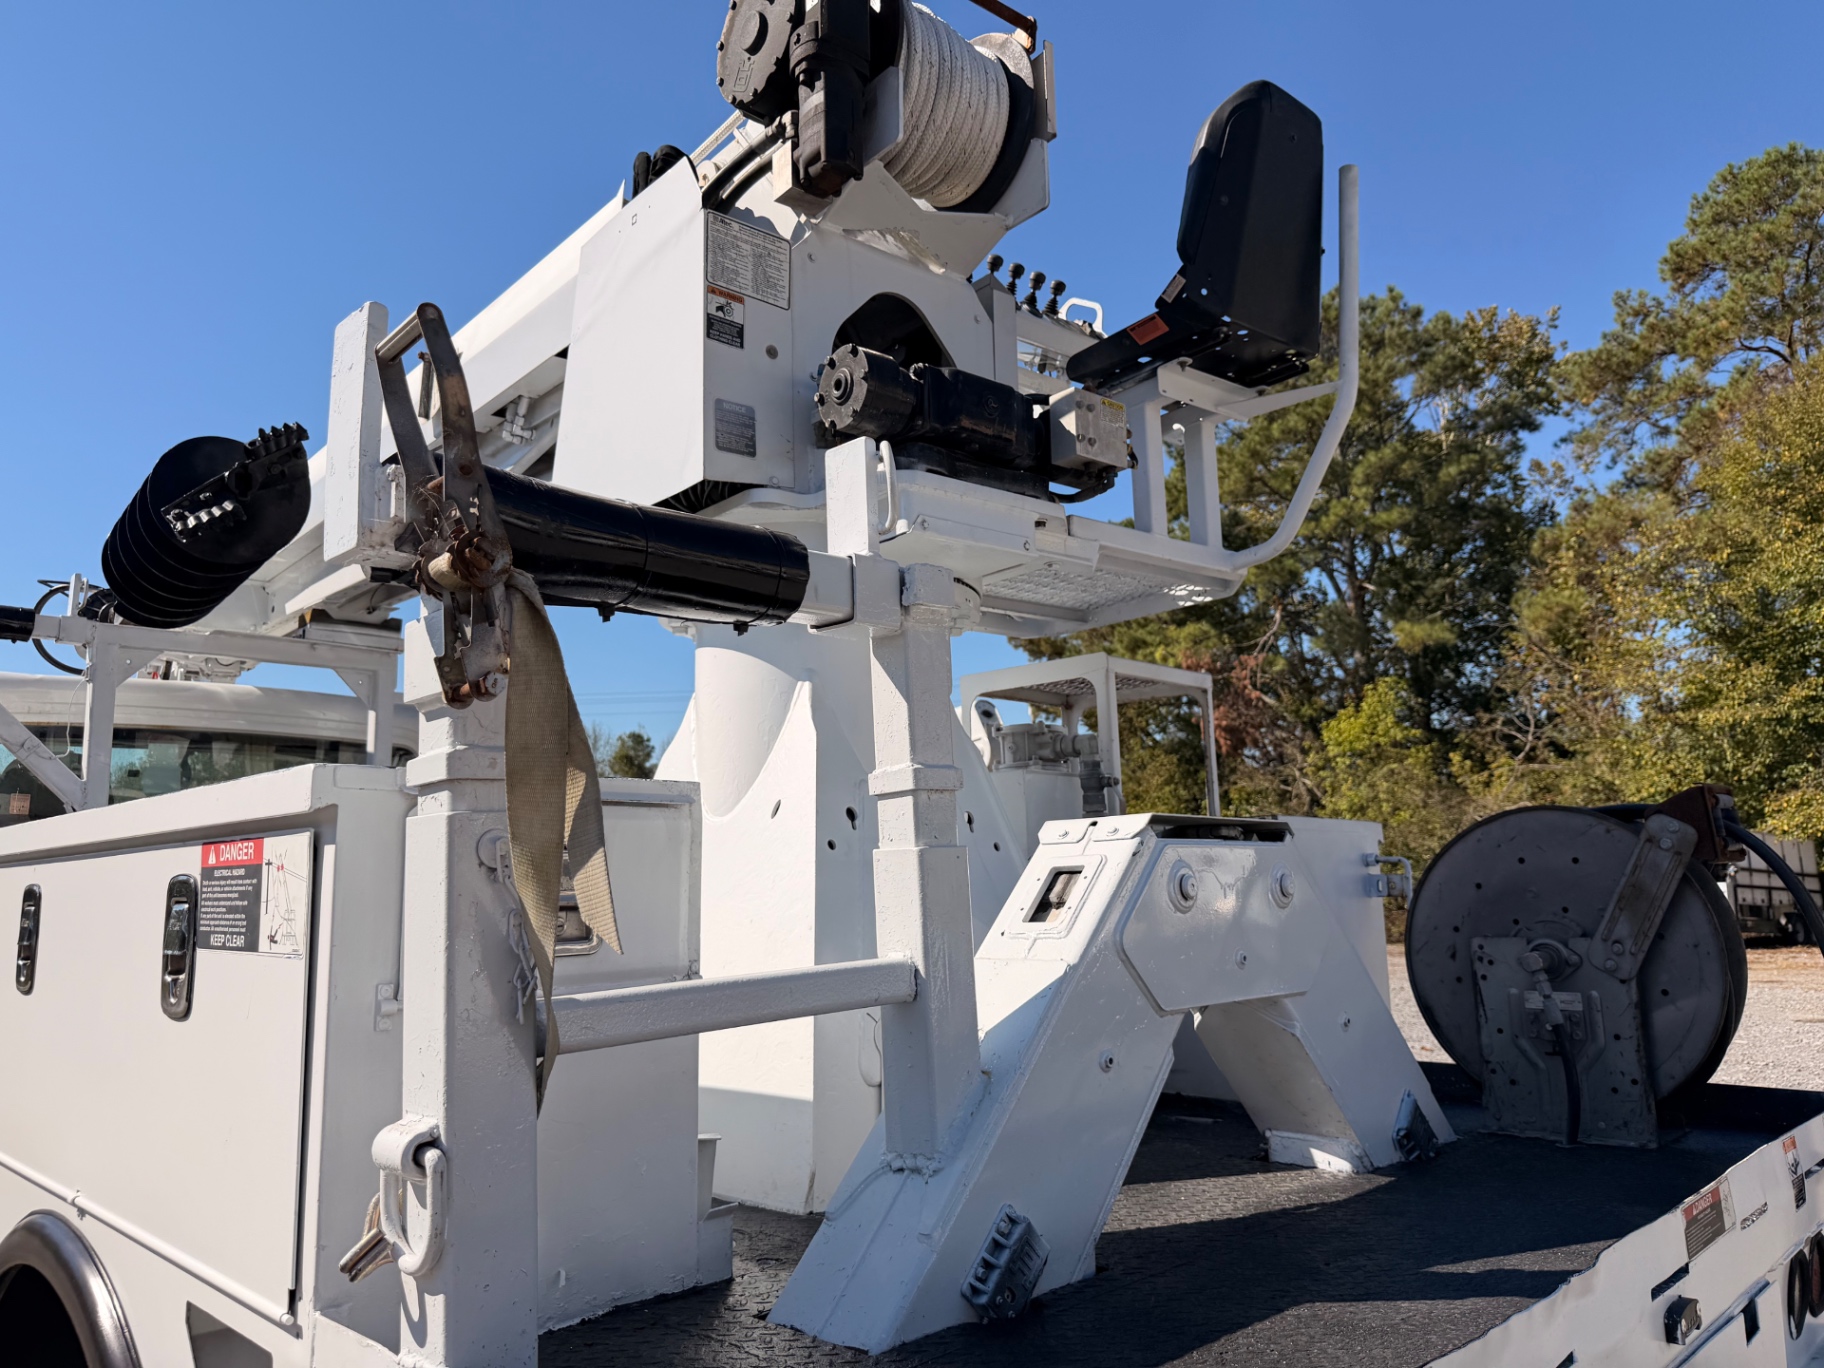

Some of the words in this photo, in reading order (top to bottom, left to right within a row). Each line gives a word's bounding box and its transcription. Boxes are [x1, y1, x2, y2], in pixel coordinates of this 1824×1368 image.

[718, 290, 743, 303] WARNING
[723, 402, 746, 413] NOTICE
[219, 842, 255, 861] DANGER
[210, 934, 225, 946] KEEP
[225, 935, 245, 947] CLEAR
[1696, 1193, 1713, 1212] DANGER
